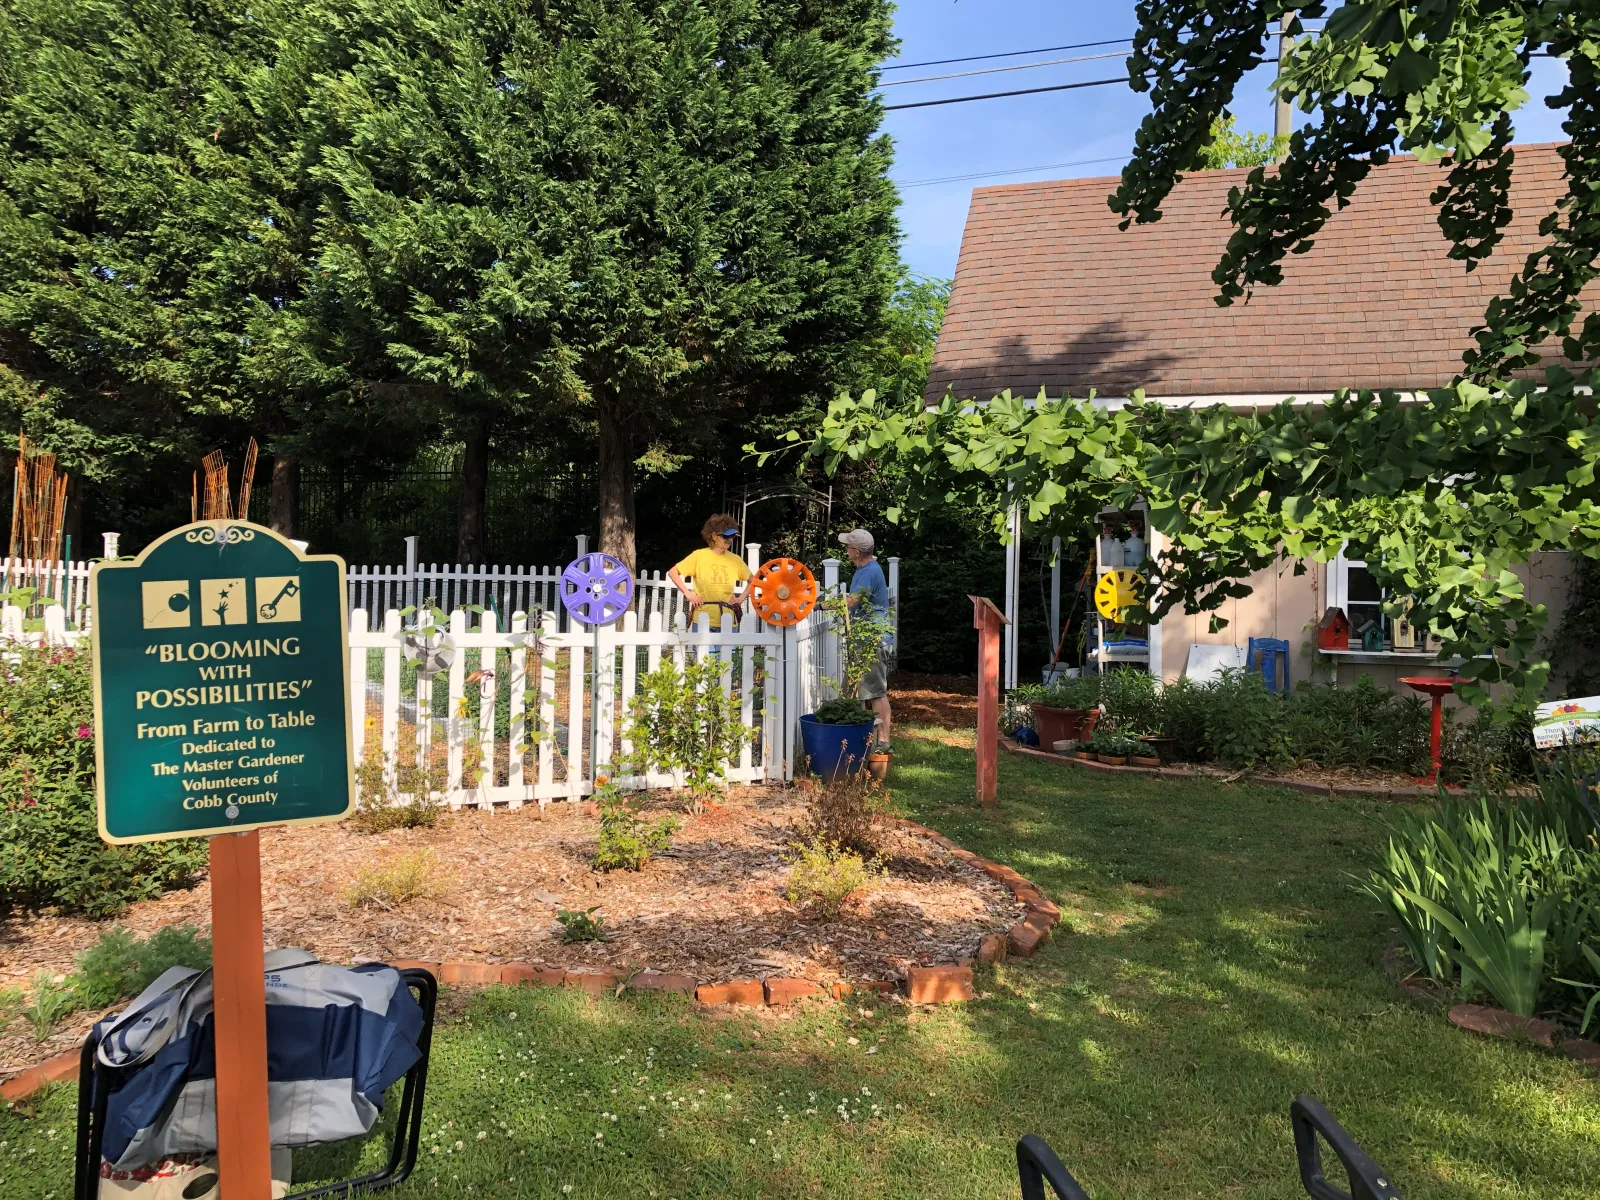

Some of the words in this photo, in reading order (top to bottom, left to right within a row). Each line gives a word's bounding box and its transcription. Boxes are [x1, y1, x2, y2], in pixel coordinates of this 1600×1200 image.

[198, 664, 251, 681] WITH
[135, 679, 313, 709] POSSIBILITIES”
[136, 723, 187, 739] From
[192, 719, 240, 735] Farm
[245, 716, 264, 731] to
[267, 710, 315, 729] Table
[181, 736, 257, 755] Dedicated
[260, 737, 276, 749] to
[151, 762, 179, 776] The
[183, 758, 234, 773] Master
[237, 751, 305, 769] Gardener
[181, 775, 260, 792] Volunteers
[263, 770, 279, 784] of
[182, 795, 223, 810] Cobb
[226, 790, 279, 805] County
